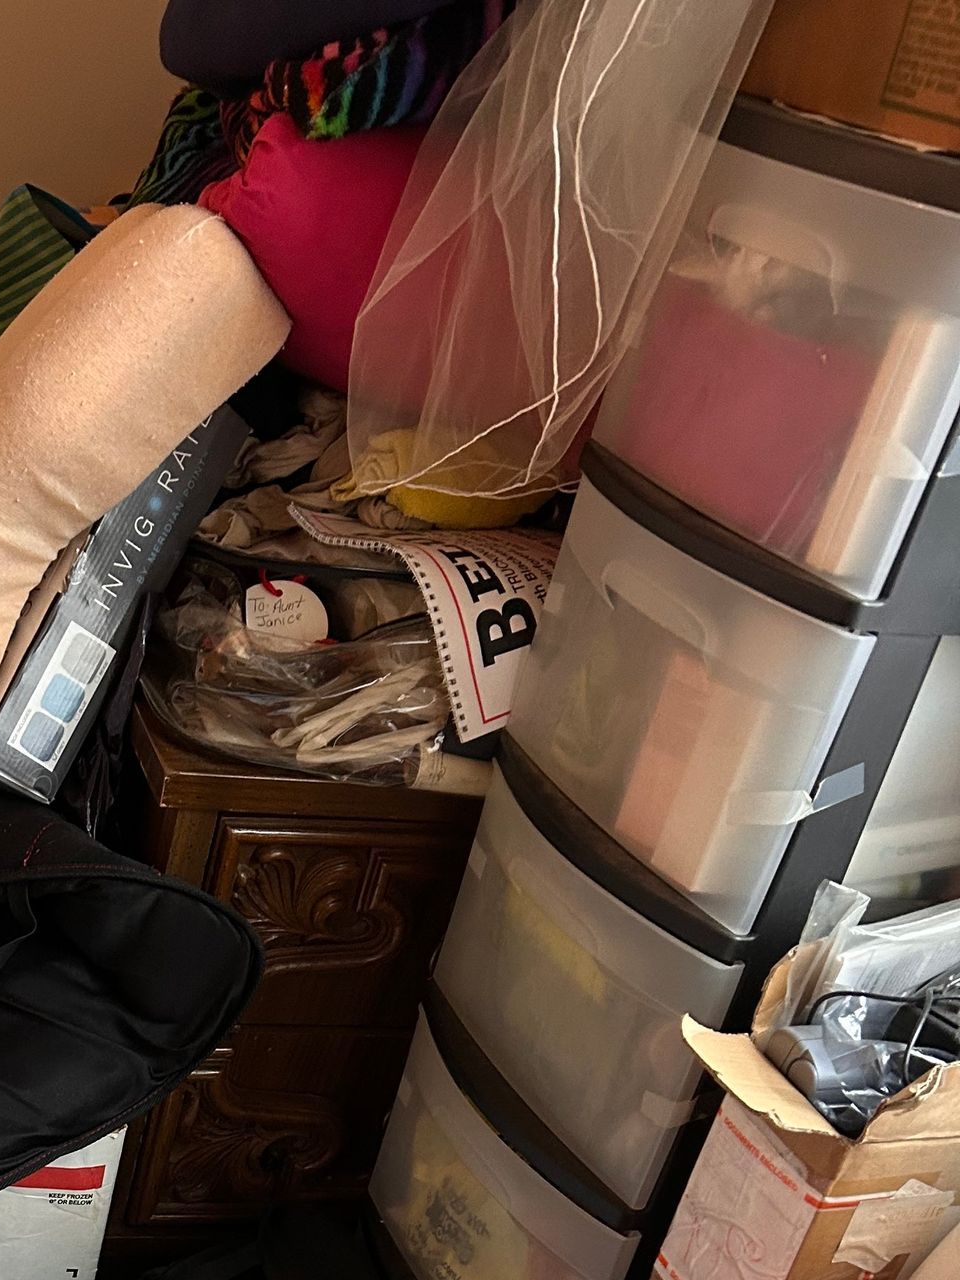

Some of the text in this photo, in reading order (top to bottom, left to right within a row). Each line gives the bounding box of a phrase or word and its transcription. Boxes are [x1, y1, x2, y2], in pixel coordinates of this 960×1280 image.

[144, 499, 186, 564] MERIDIAN
[255, 612, 302, 627] Janice
[759, 1153, 800, 1193] ENCLOSED
